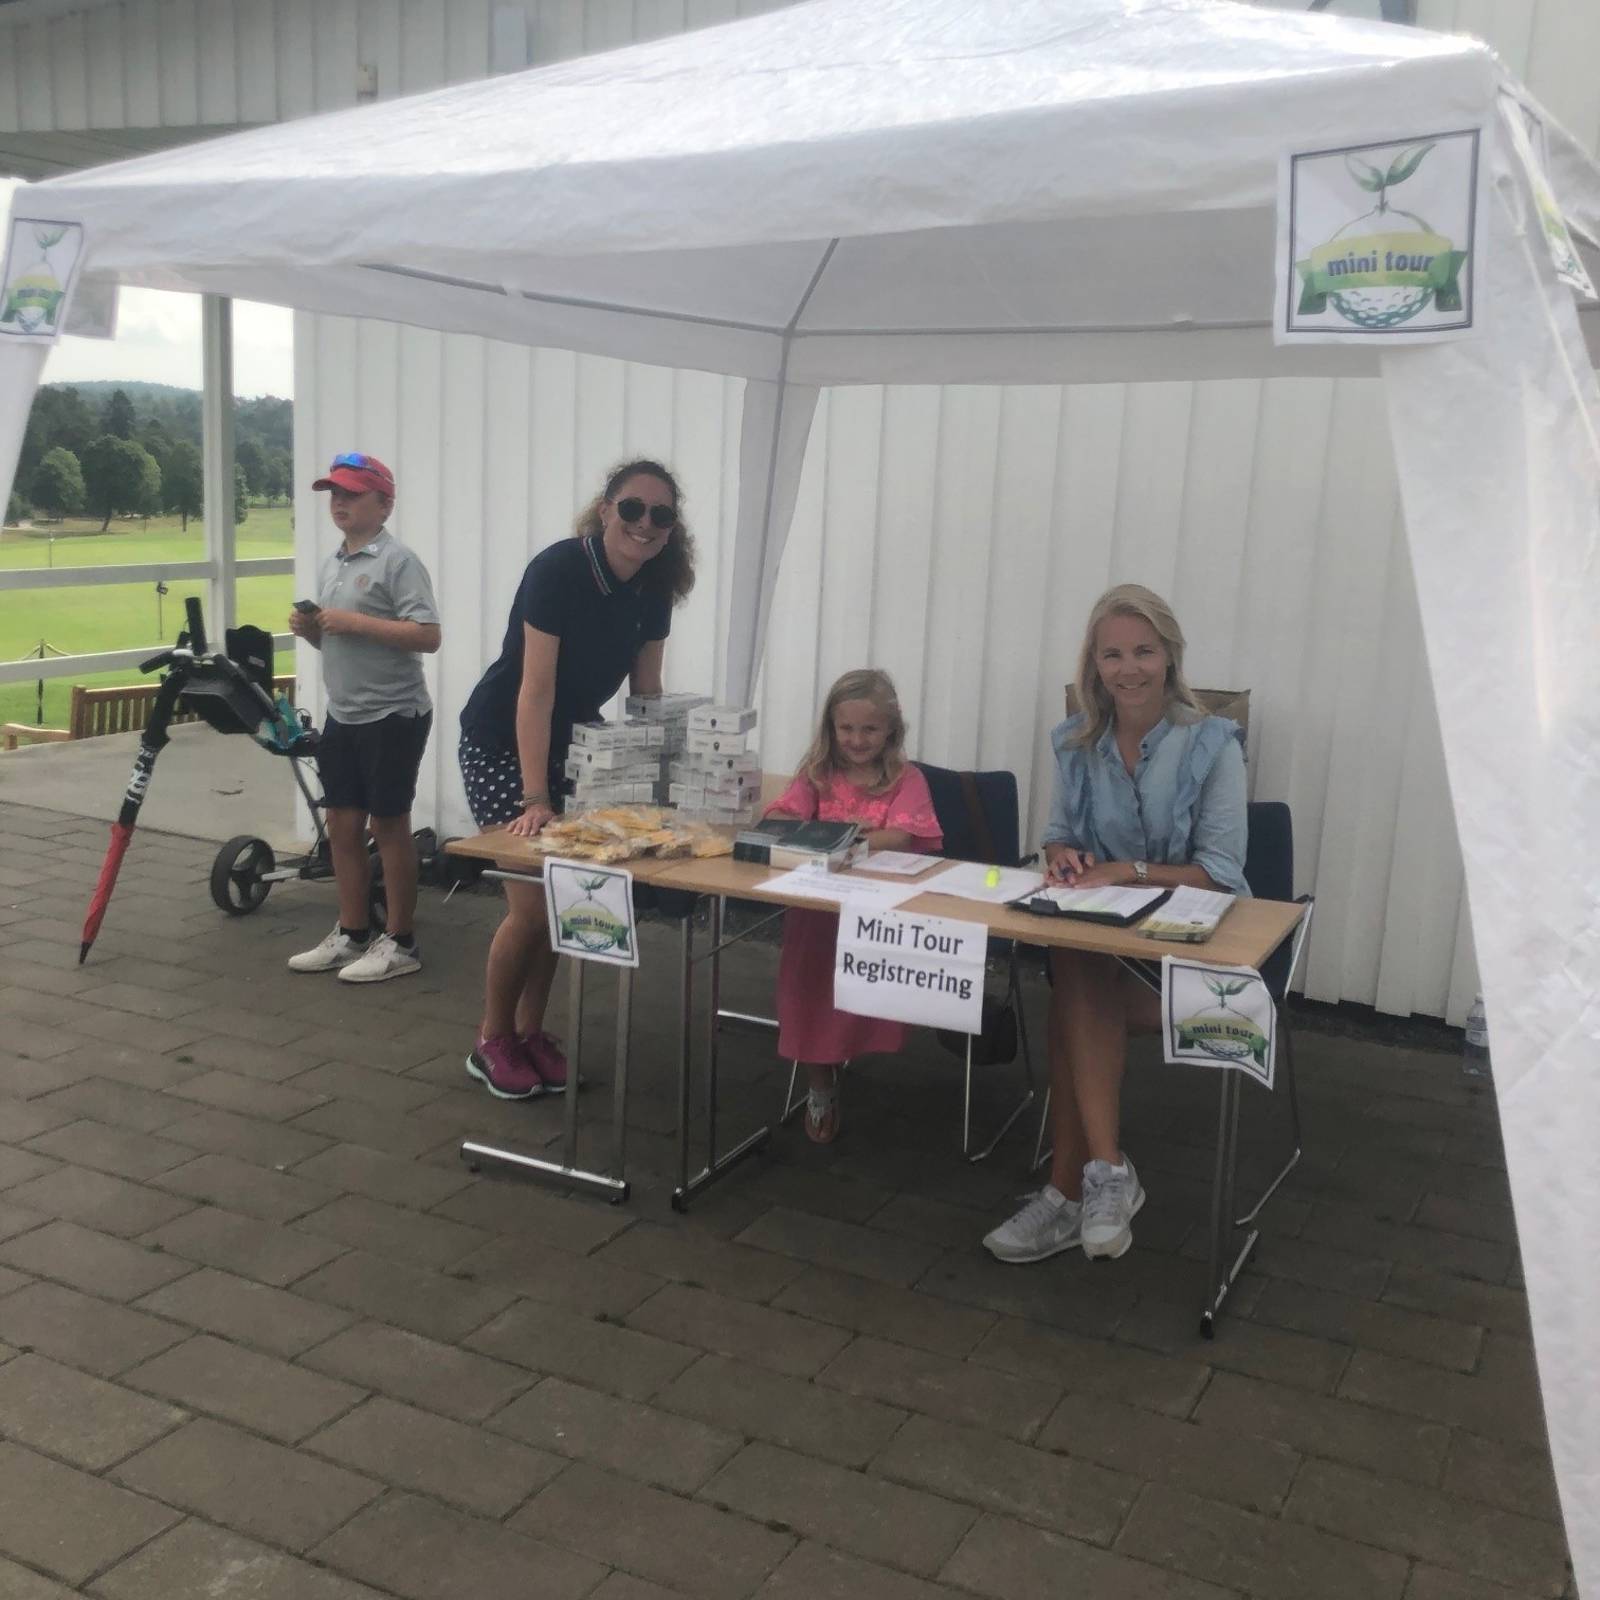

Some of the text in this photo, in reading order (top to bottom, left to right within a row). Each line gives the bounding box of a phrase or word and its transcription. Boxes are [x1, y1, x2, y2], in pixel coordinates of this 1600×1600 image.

[1327, 250, 1435, 276] mini tour
[857, 916, 963, 955] Mini Tour
[843, 952, 972, 1000] Registrering
[1192, 1023, 1255, 1039] mini tour
